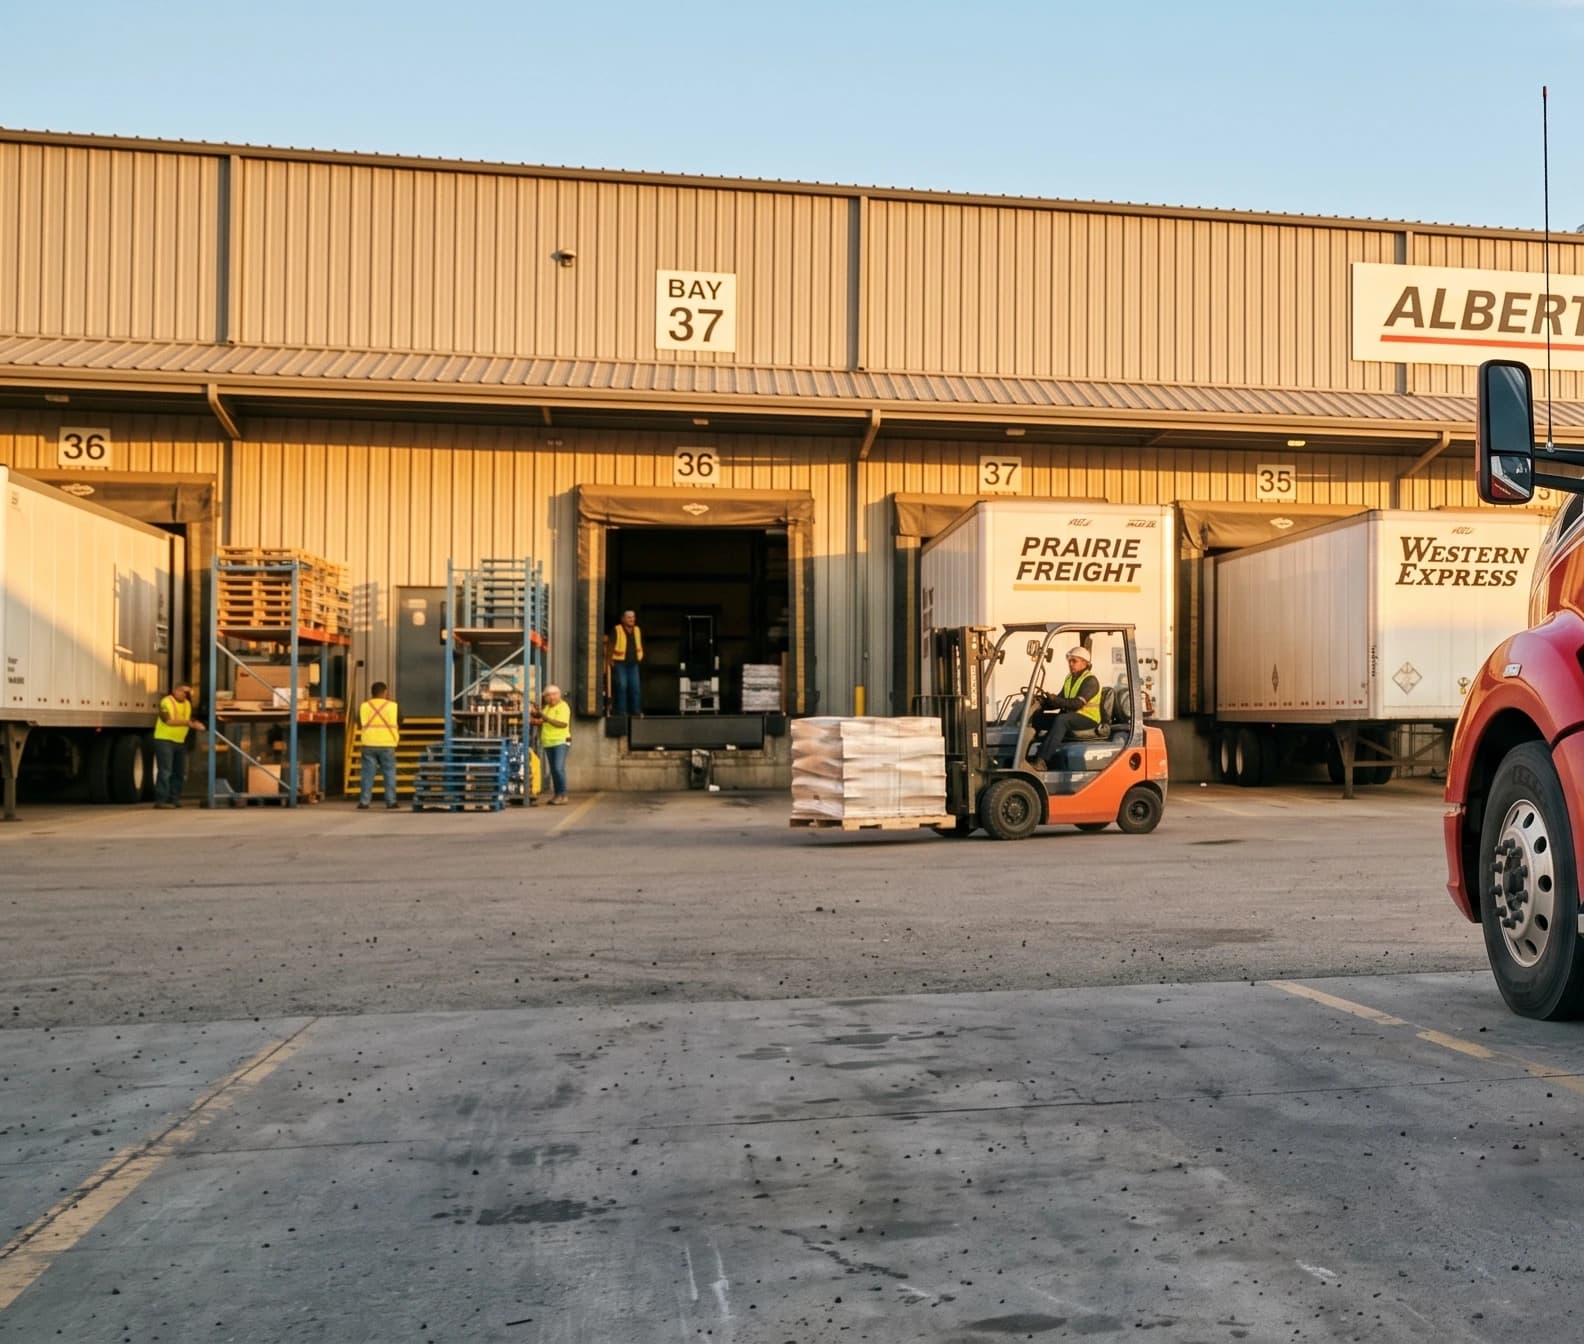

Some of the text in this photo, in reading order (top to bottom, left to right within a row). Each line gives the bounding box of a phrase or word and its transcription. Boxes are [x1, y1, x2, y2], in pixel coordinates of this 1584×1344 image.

[668, 279, 723, 300] BAY
[668, 306, 724, 342] 37
[63, 433, 106, 460] 36
[677, 452, 713, 477] 36
[984, 462, 1019, 486] 37
[1260, 470, 1291, 493] 35
[1021, 536, 1141, 559] PRAIRIE
[1400, 536, 1530, 564] WESTERN
[1016, 561, 1142, 583] FREIGHT
[1395, 563, 1518, 587] EXPRESS
